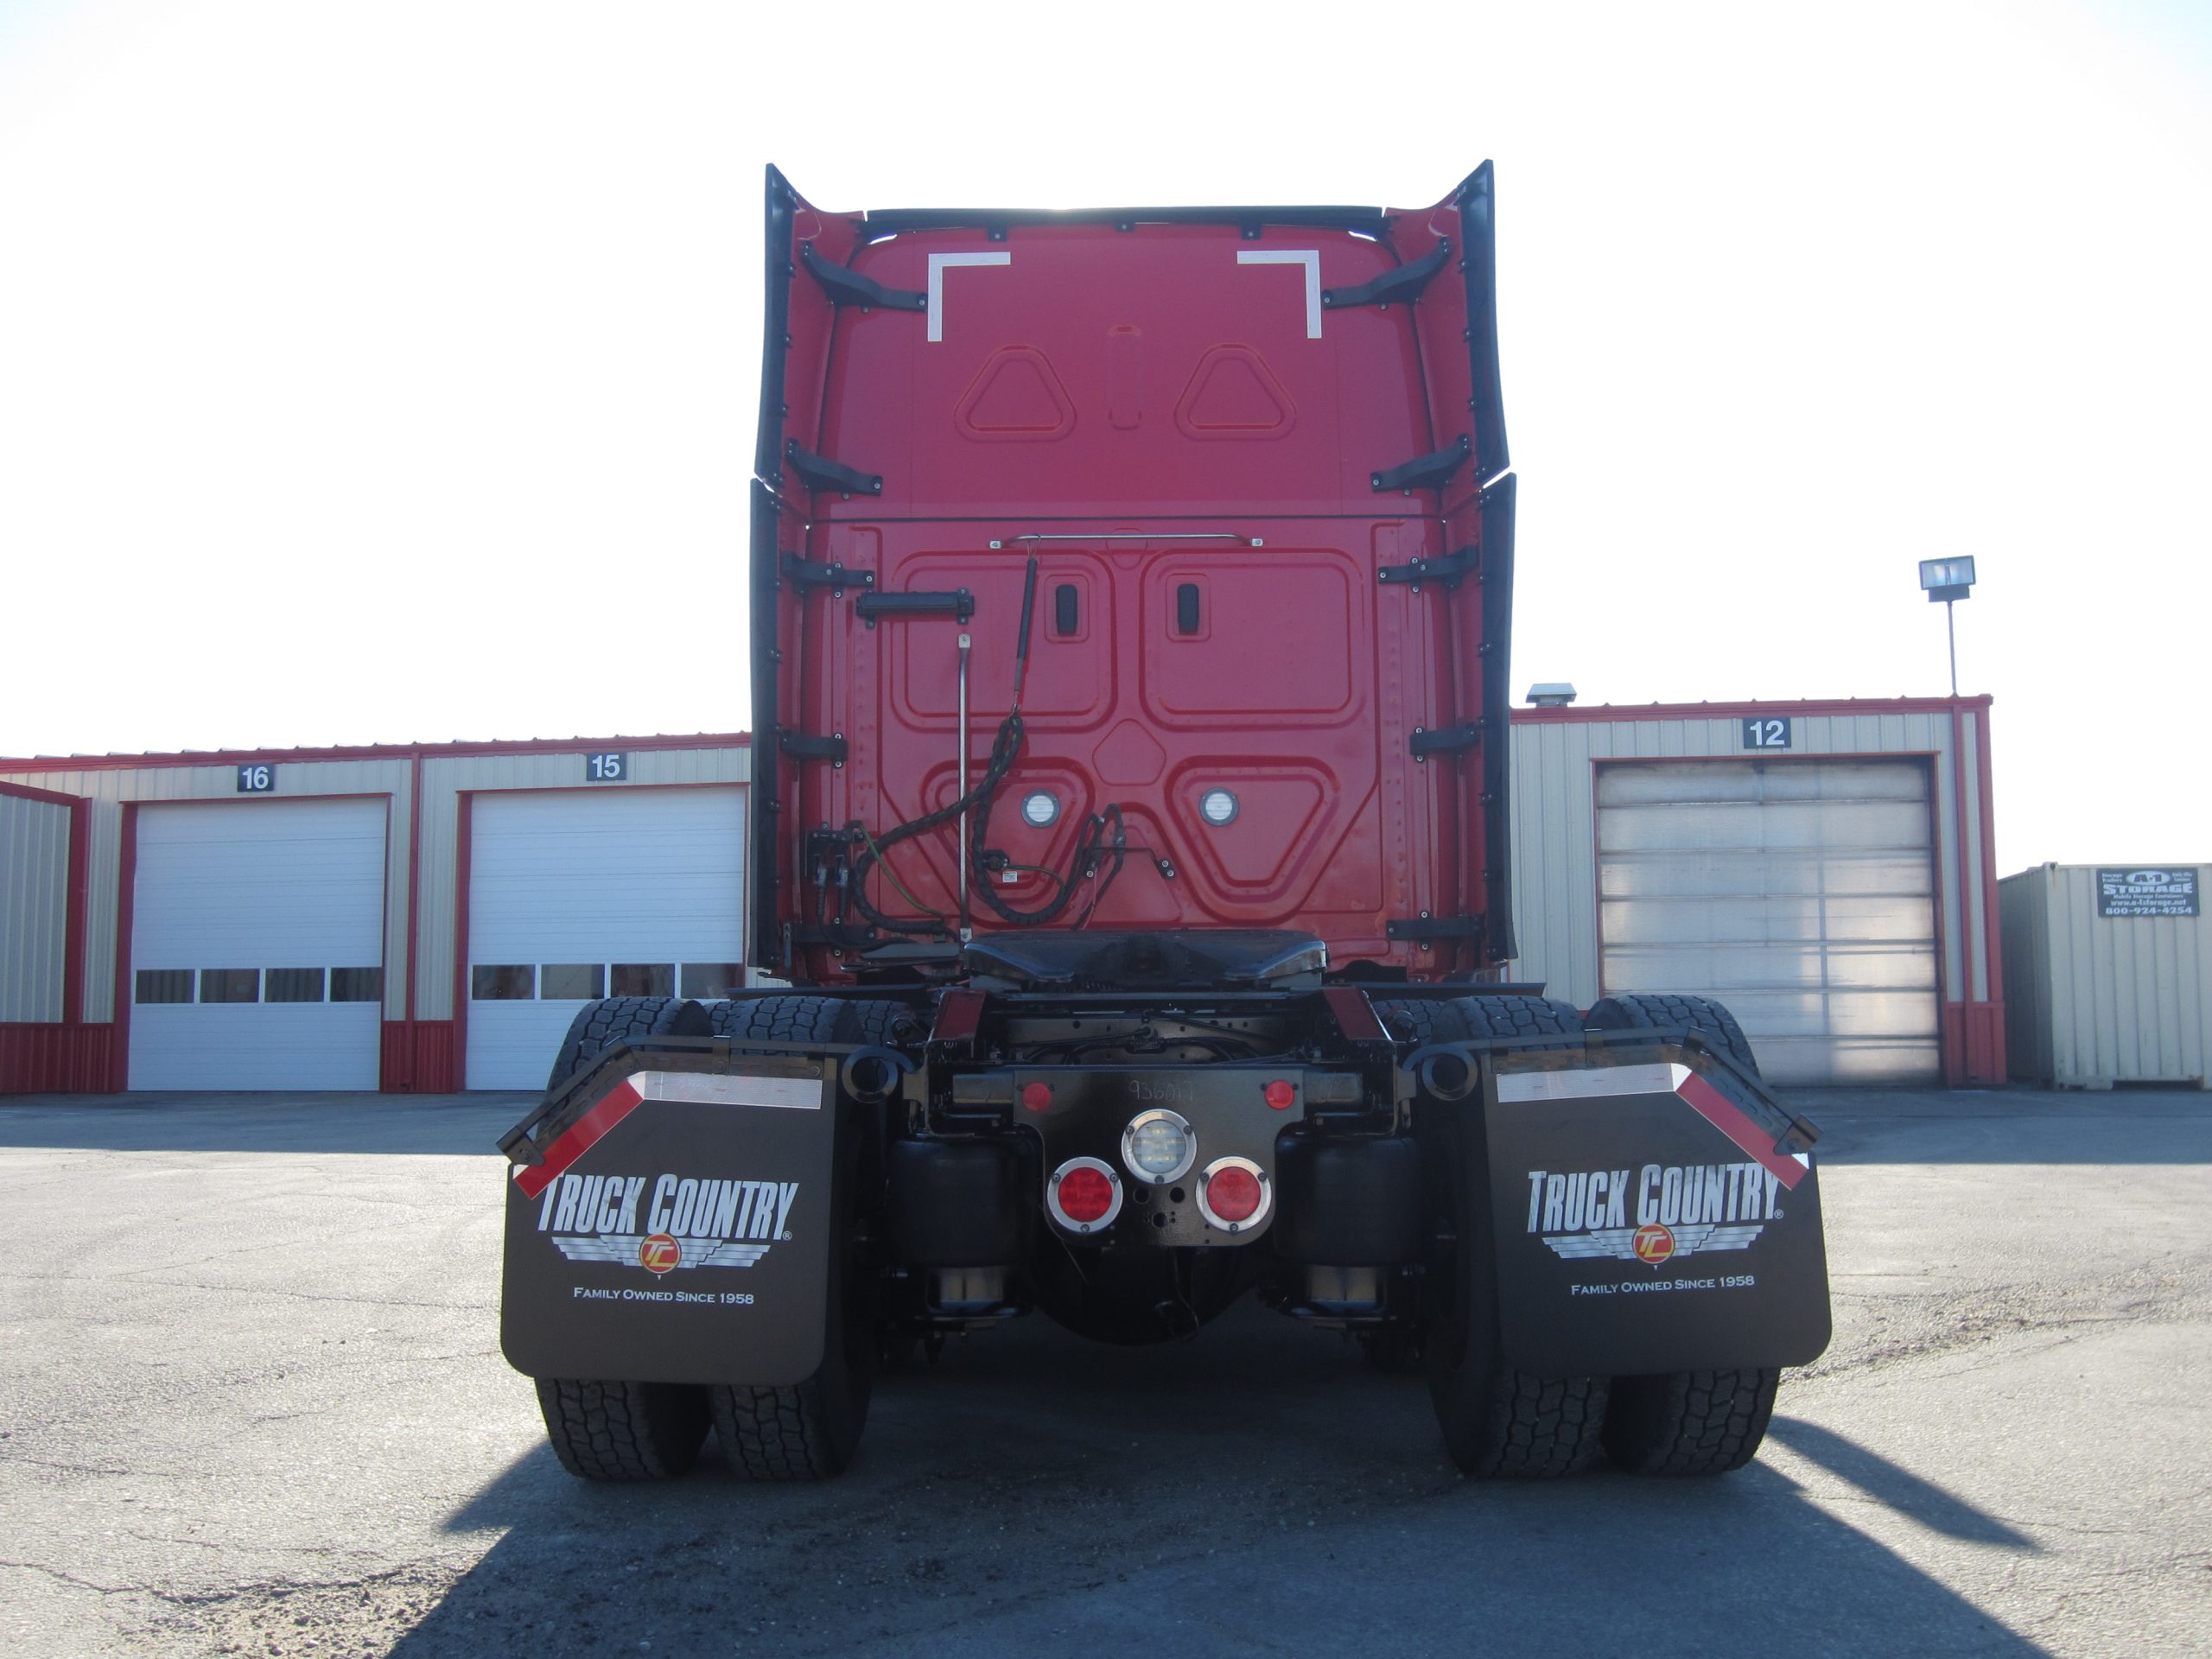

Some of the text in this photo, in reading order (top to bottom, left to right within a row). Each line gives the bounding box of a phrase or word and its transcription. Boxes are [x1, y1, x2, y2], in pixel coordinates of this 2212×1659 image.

[1750, 720, 1785, 746] 12
[592, 754, 620, 778] 15
[242, 766, 269, 789] 16
[2133, 874, 2163, 882] A-1
[2102, 882, 2193, 895] STORAGE
[2105, 906, 2193, 915] 800-924-4254
[537, 1173, 799, 1240] TRUCK COUNTRY
[1527, 1162, 1779, 1233] TRUCK COUNTRY
[1719, 1274, 1756, 1287] 1958
[720, 1293, 755, 1305] 1958
